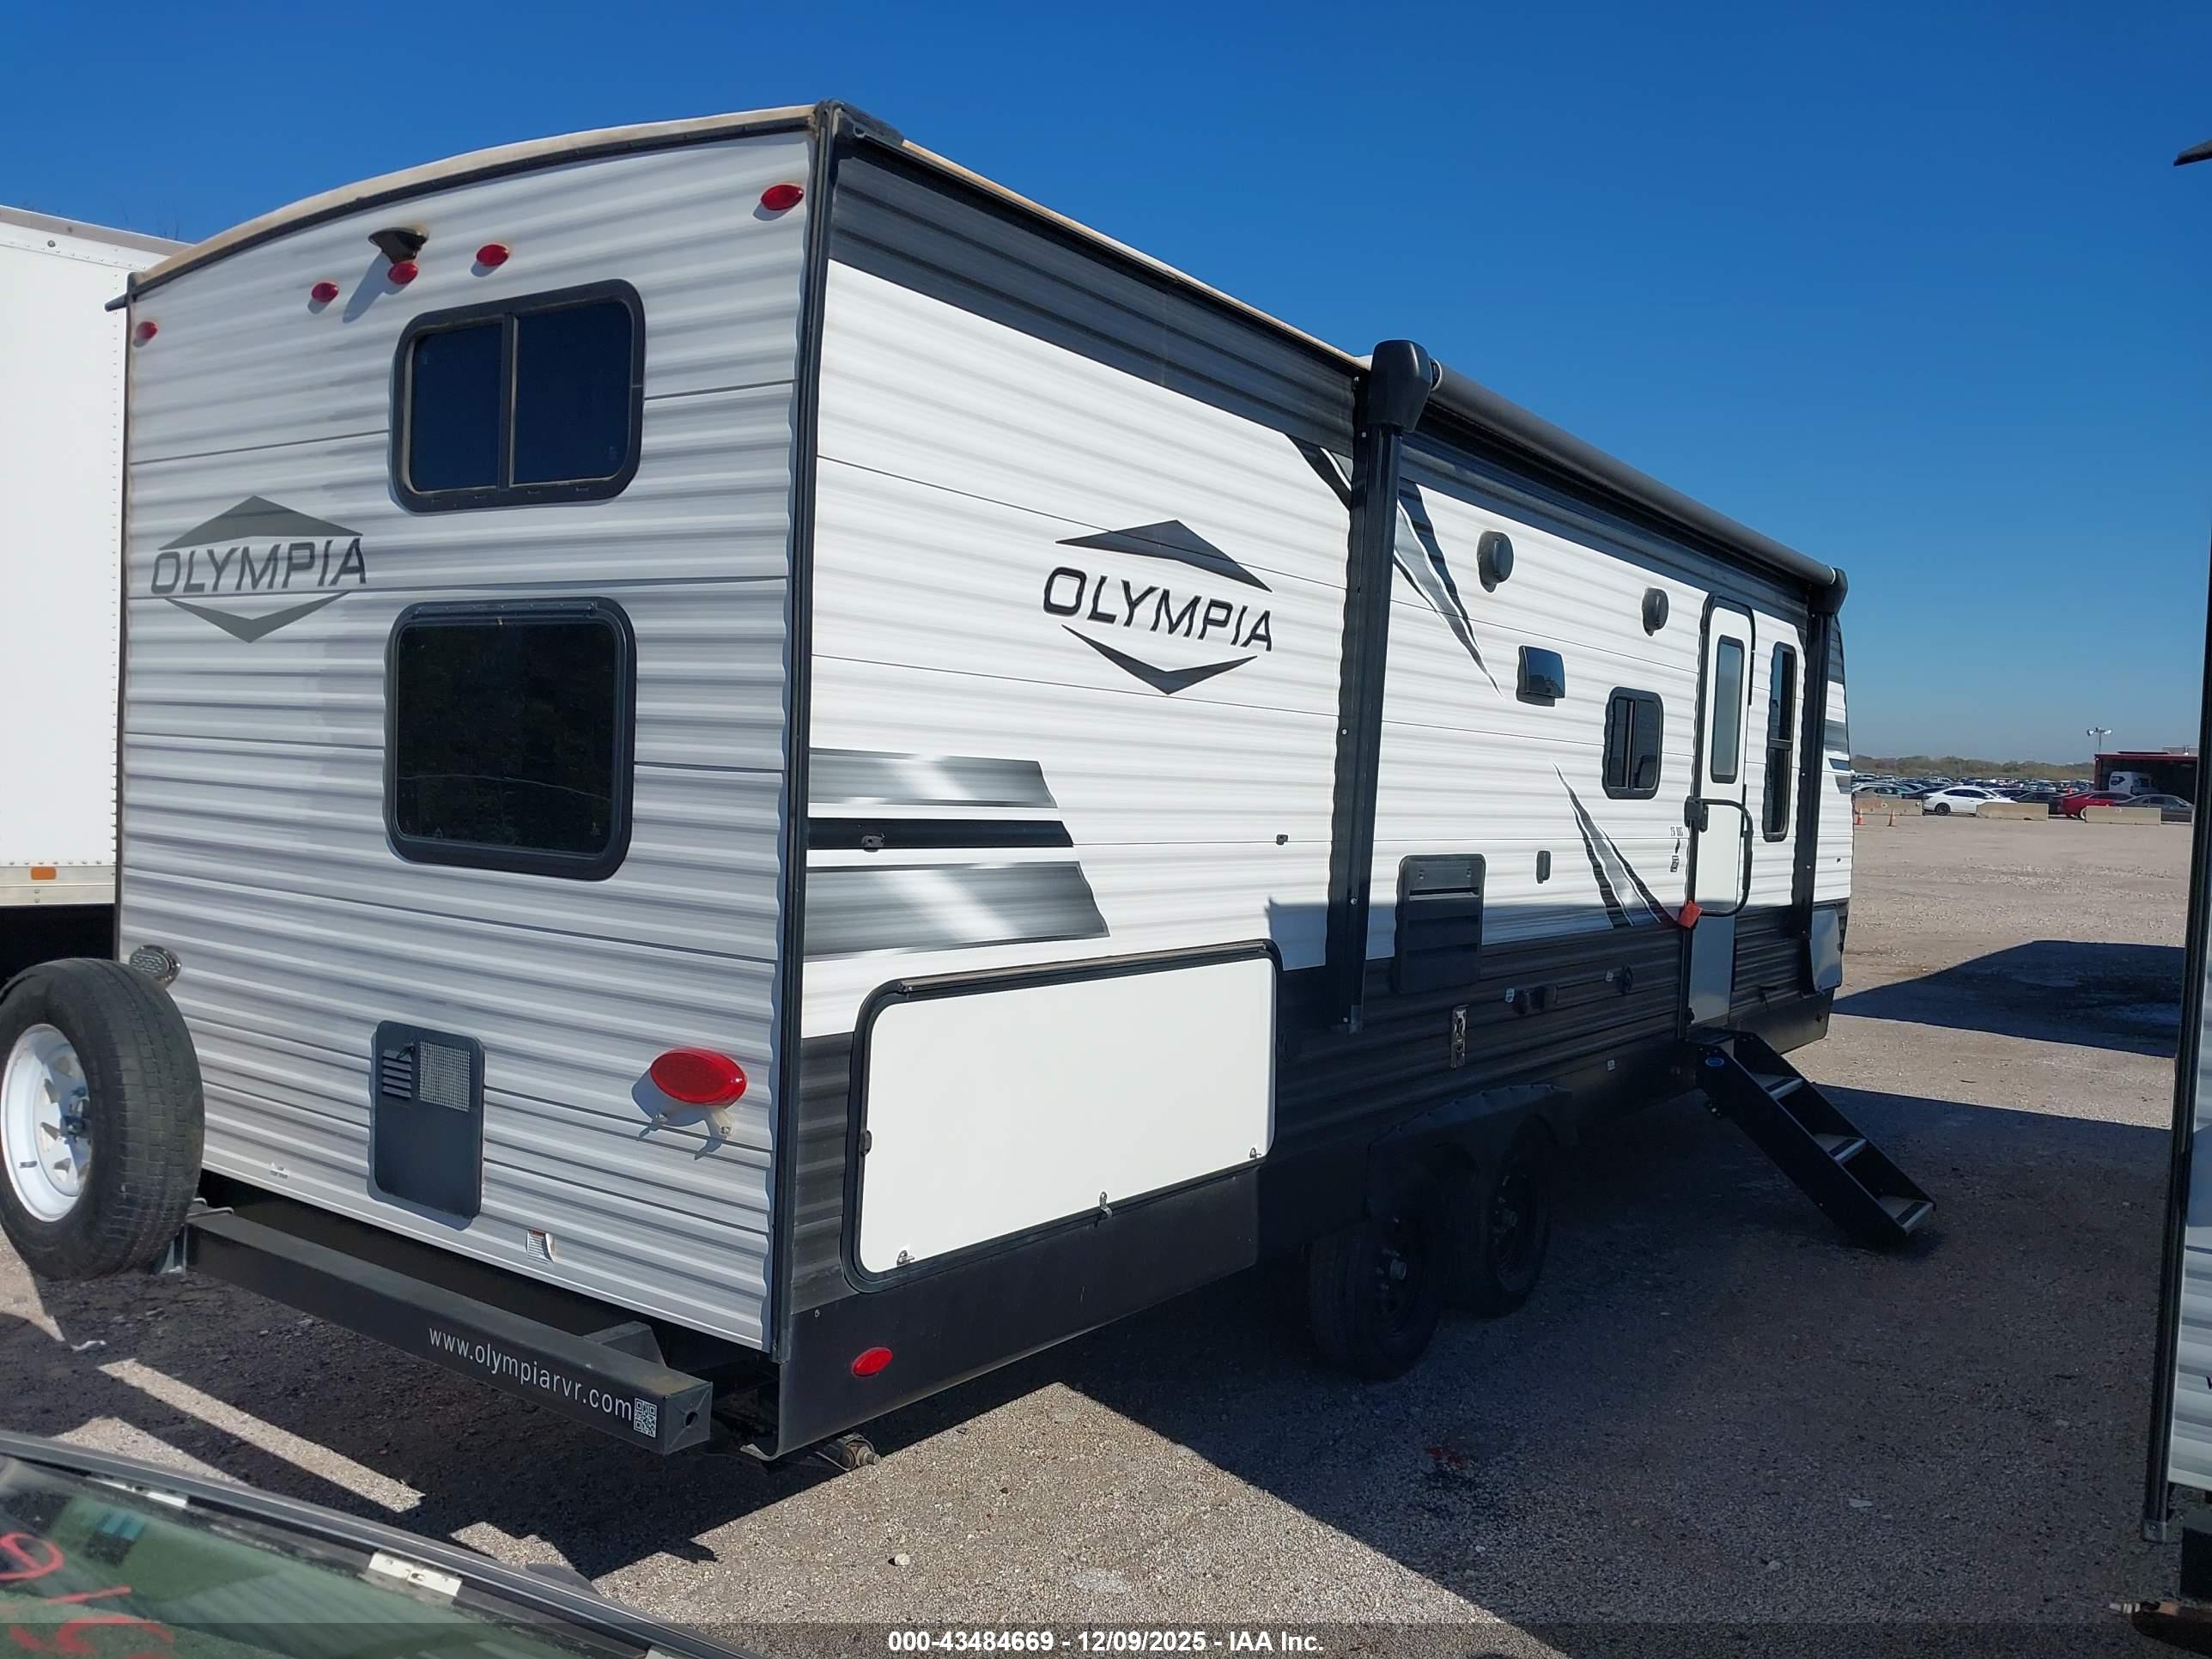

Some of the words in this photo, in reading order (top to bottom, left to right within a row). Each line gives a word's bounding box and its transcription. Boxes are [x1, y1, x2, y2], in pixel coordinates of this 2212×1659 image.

[150, 537, 367, 594] OLYMPIA
[1042, 566, 1273, 652] OLYMPIA
[428, 1327, 632, 1422] www.olympiarvr.com
